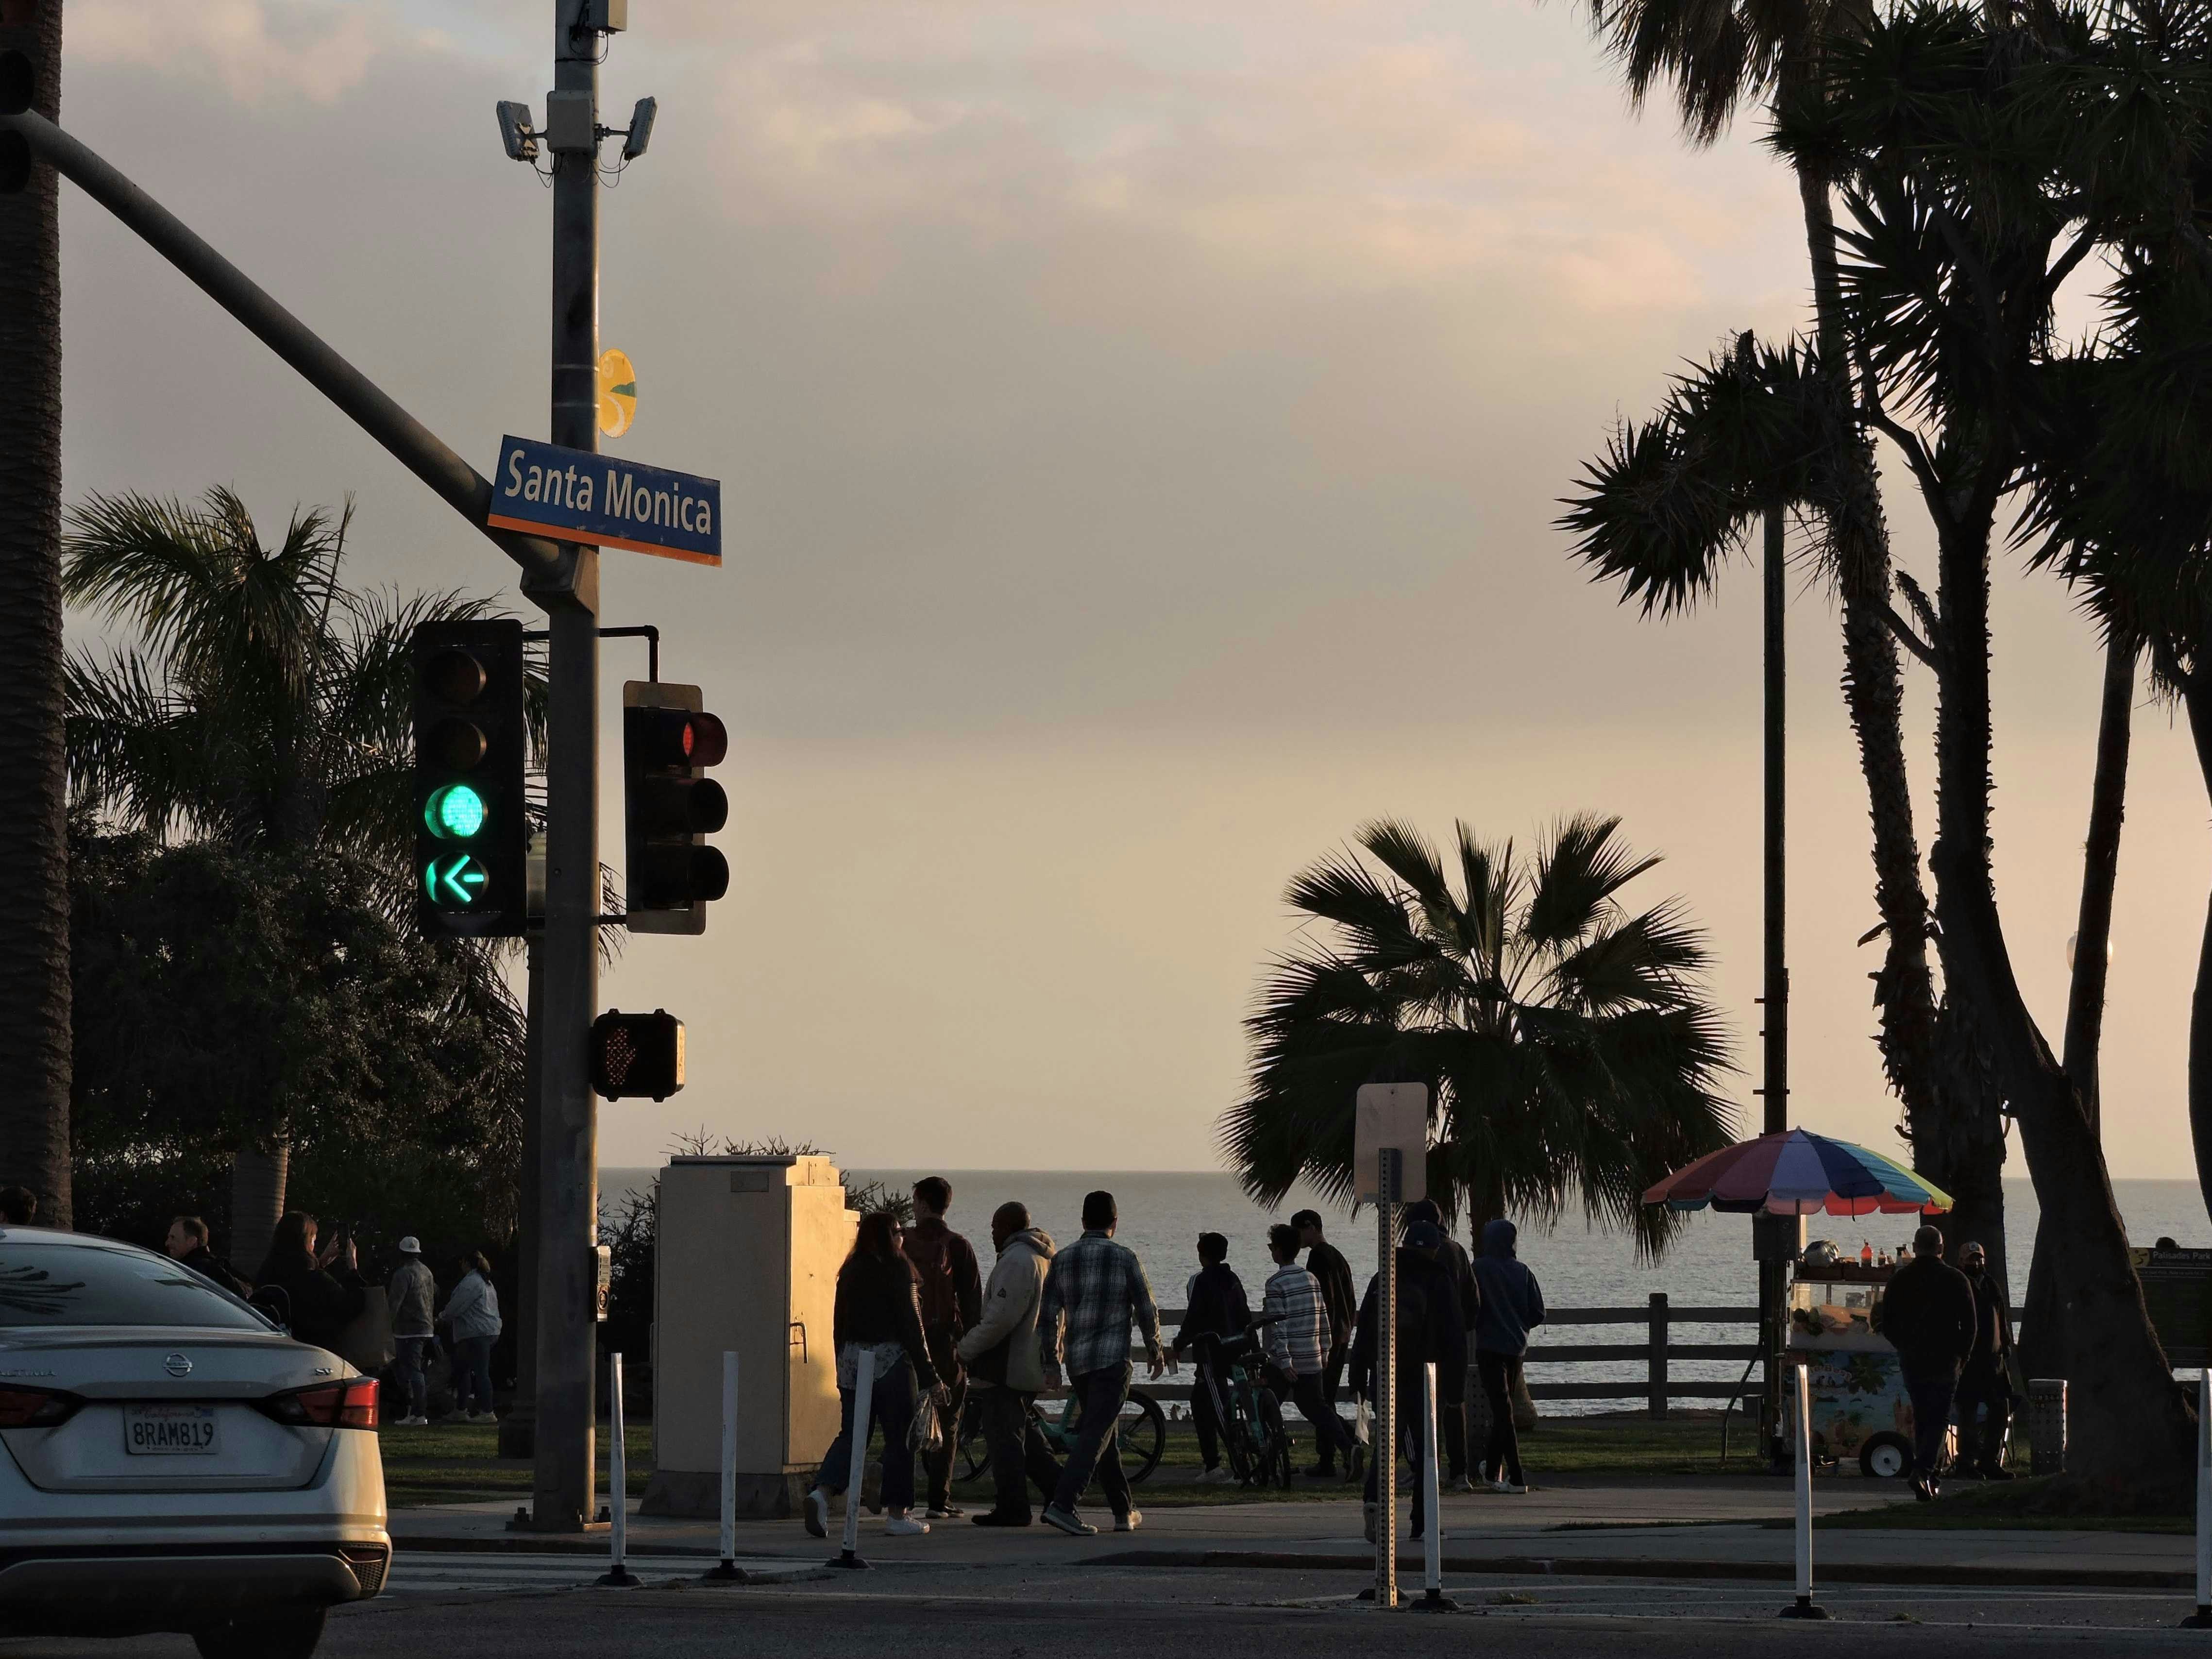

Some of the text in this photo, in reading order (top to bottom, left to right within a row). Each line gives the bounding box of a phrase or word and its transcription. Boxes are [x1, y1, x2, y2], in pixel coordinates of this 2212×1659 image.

[505, 450, 711, 534] Santa Monica
[2153, 1251, 2211, 1260] Palisades Park
[134, 1422, 214, 1446] 8RAM819
